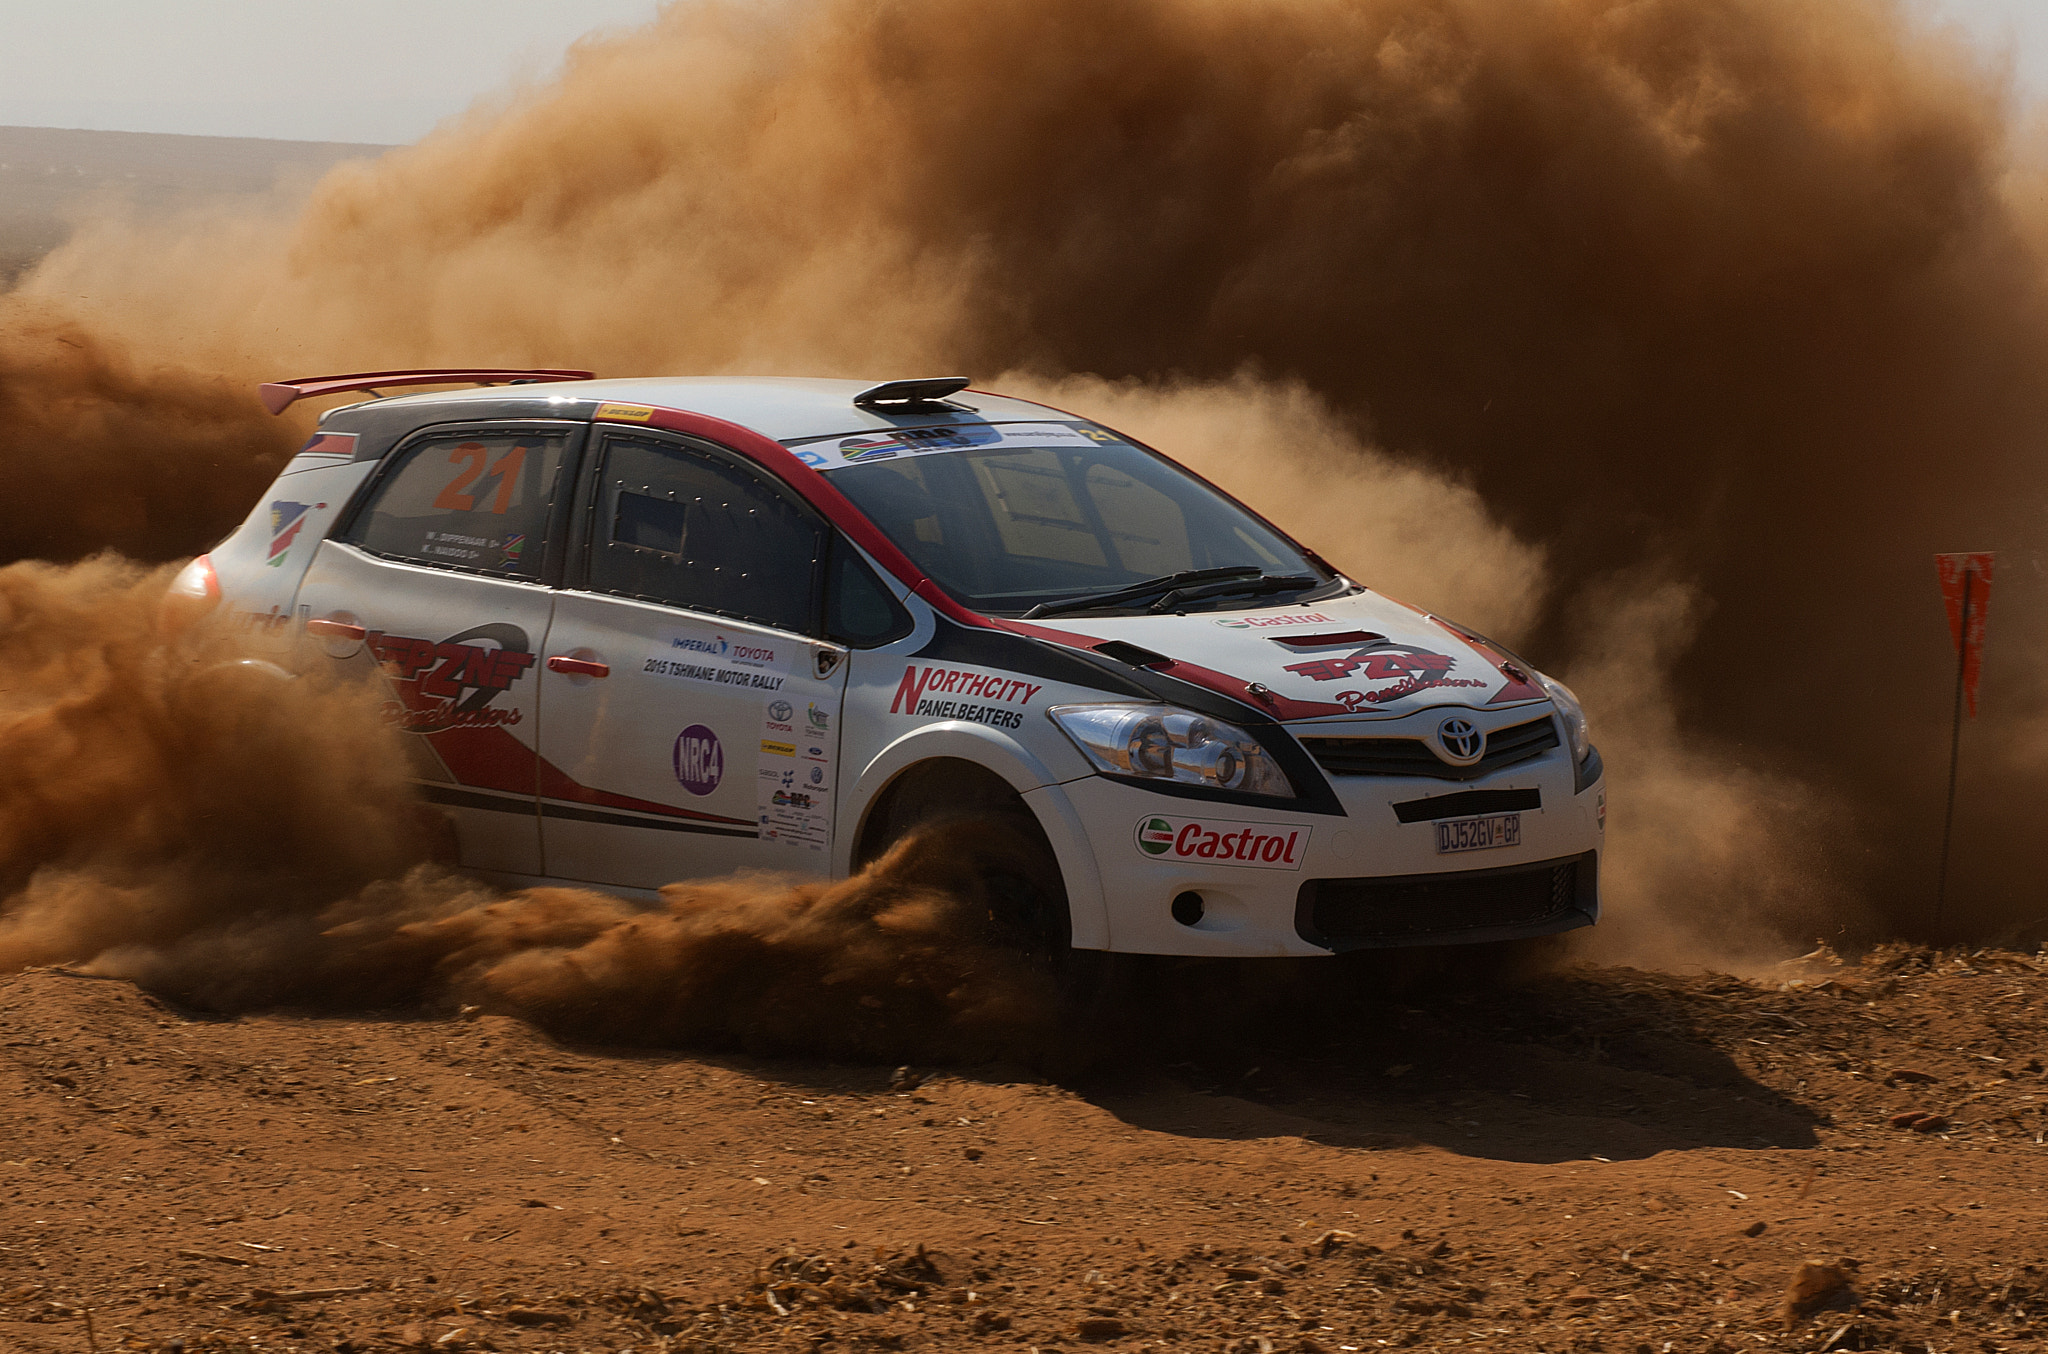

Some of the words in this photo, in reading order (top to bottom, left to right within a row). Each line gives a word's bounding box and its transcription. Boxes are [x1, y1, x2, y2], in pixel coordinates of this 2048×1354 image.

[1077, 429, 1121, 442] 21
[432, 442, 528, 515] 21
[1247, 611, 1337, 628] Castrol
[671, 637, 718, 655] IMPERIAL
[733, 646, 775, 662] TOYOTA
[643, 658, 668, 675] 2015
[667, 662, 717, 681] TSHWANE
[715, 669, 751, 687] MOTOR
[750, 674, 784, 691] RALLY
[889, 665, 1042, 716] NORTHCITY
[766, 721, 793, 732] TOYOTA
[915, 699, 1024, 730] PANELBEATERS
[679, 736, 719, 785] NRC4
[1175, 823, 1299, 864] Castrol
[1440, 819, 1494, 850] DJ52GV
[1504, 815, 1520, 843] GP
